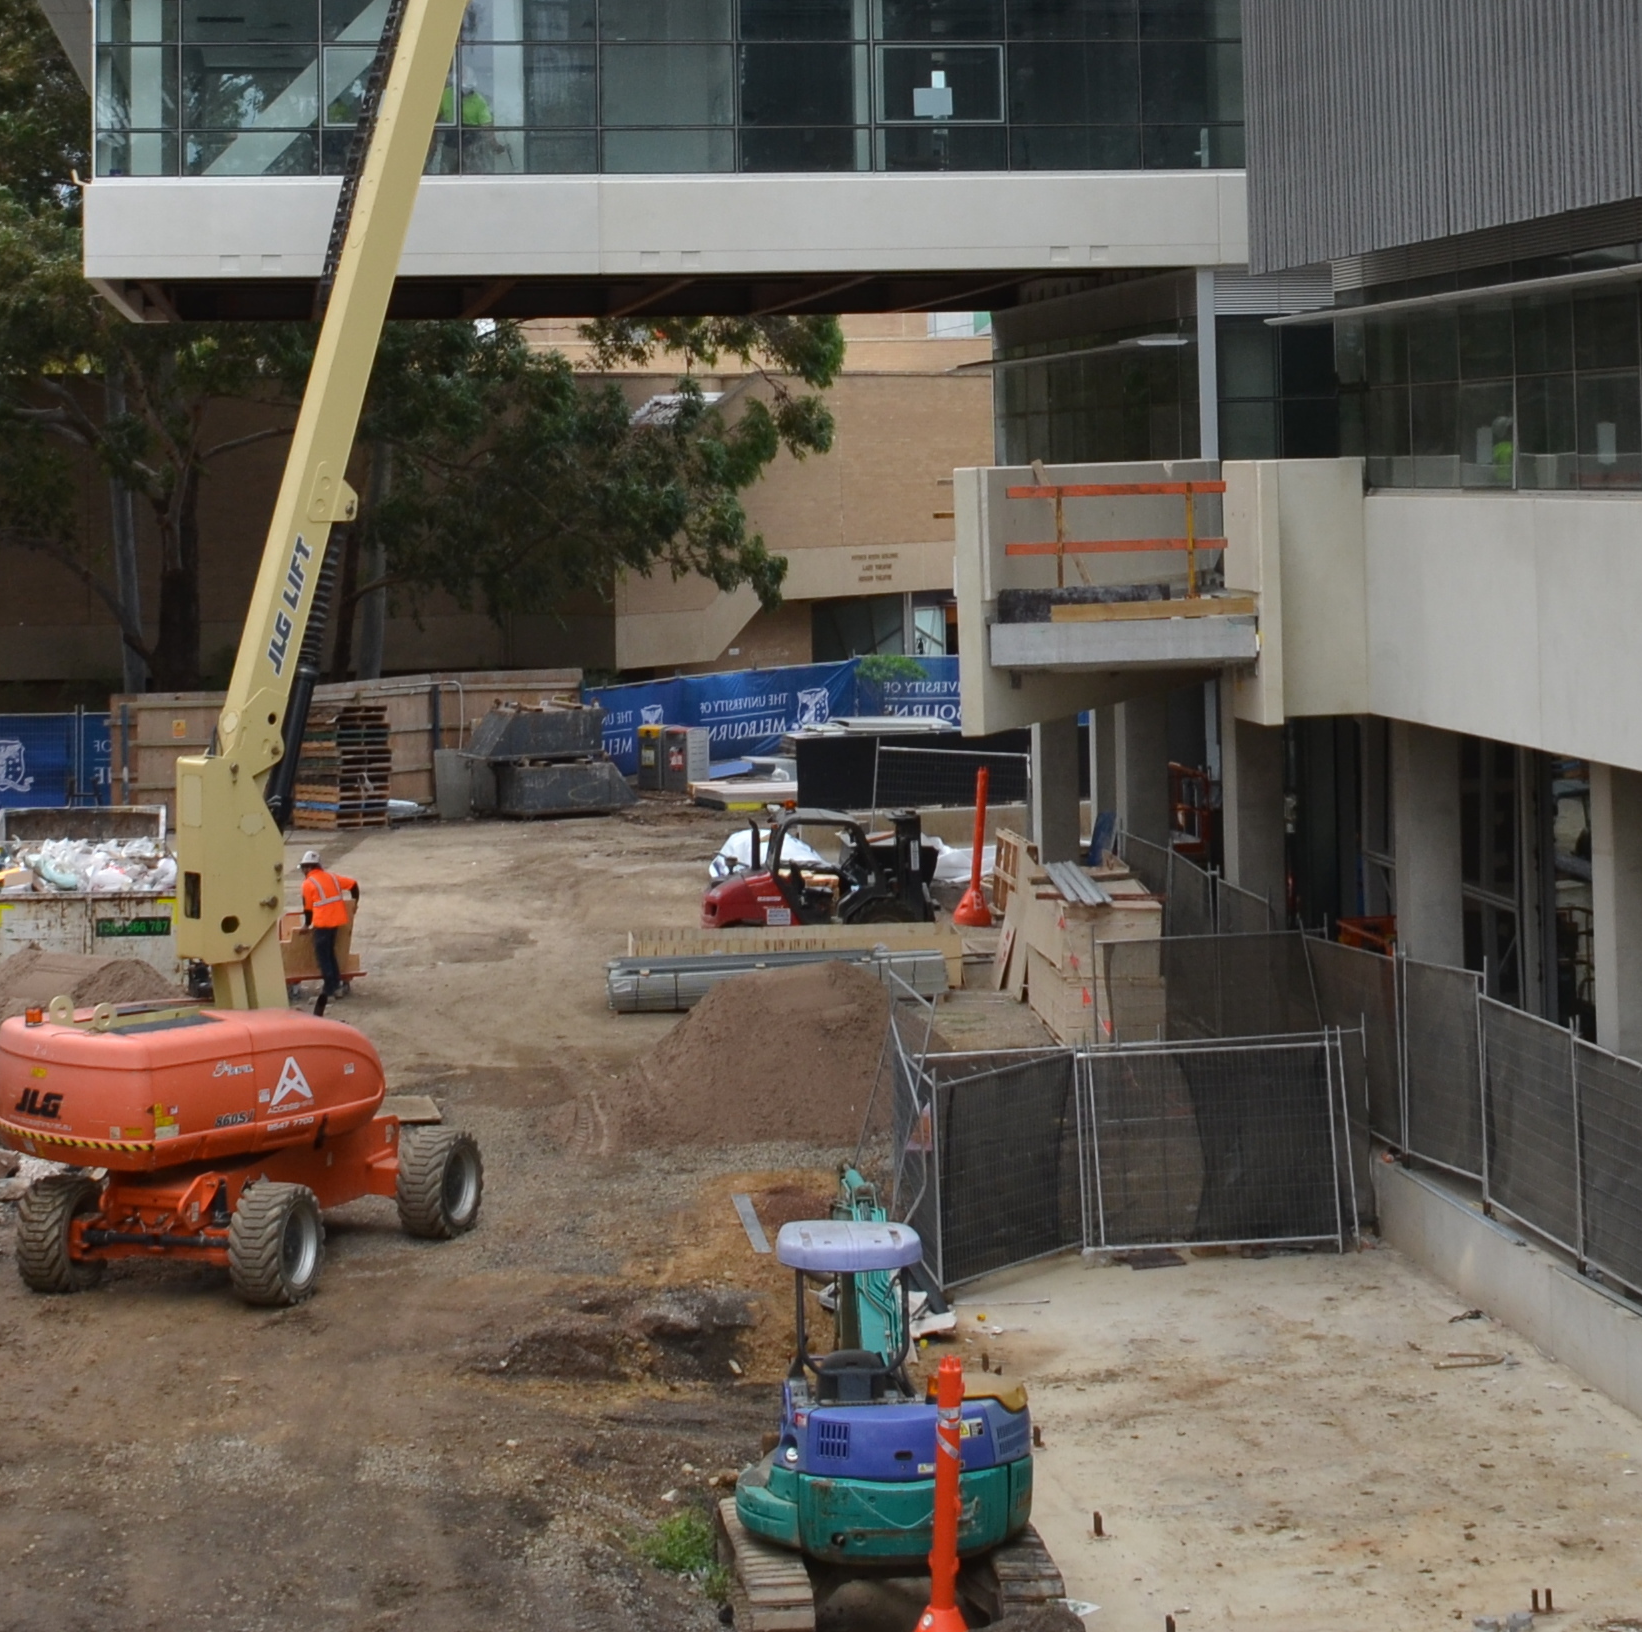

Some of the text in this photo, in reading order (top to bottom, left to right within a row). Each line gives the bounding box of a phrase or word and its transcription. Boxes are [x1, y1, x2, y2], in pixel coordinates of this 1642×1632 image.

[268, 532, 314, 678] JLG LIFT
[15, 1087, 64, 1119] JLG
